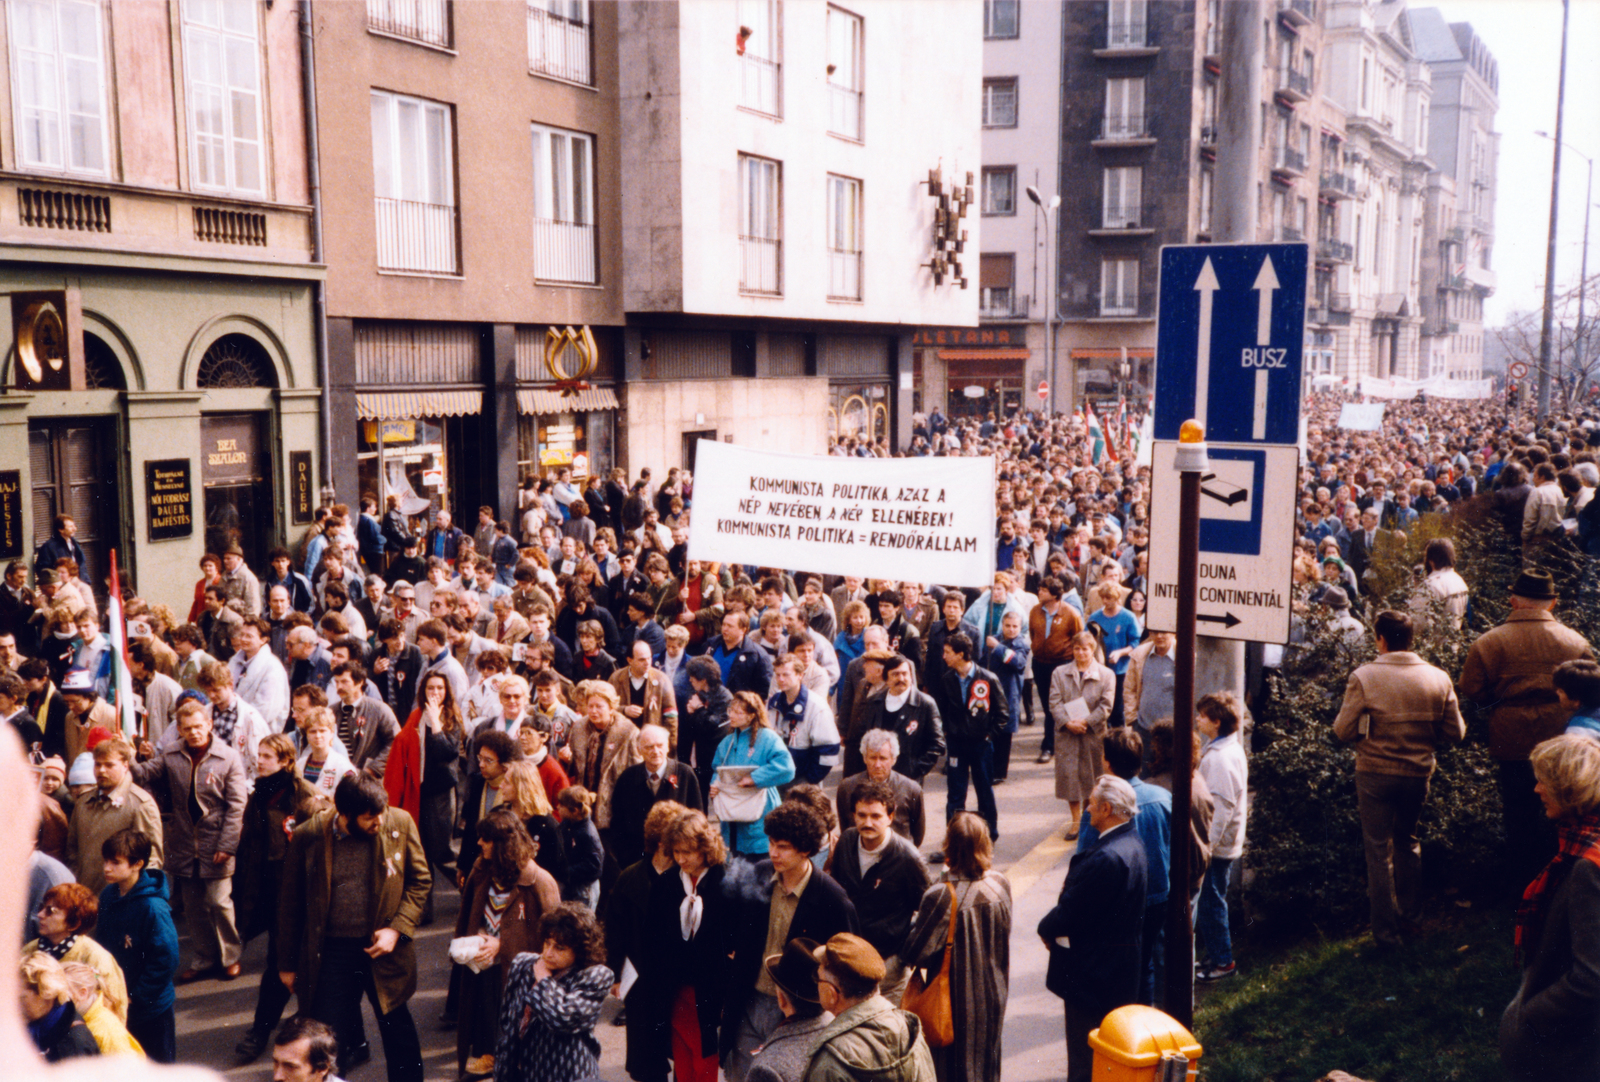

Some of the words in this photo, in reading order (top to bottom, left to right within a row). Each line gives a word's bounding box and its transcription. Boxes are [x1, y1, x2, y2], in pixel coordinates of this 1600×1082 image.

[1241, 348, 1287, 369] BUSZ
[298, 462, 308, 513] DAUER
[750, 476, 824, 497] KOMMUNISTA
[832, 483, 891, 503] POLITIKA,
[895, 488, 930, 502] AZAZ
[936, 488, 946, 503] A
[157, 504, 185, 516] DAUER
[738, 495, 762, 514] NÉP
[767, 499, 822, 522] NEVÉBEN,
[826, 507, 837, 521] A
[840, 504, 863, 522] NÉP
[871, 505, 954, 527] ELLENÉBEN!
[717, 518, 791, 540] KOMMUNISTA
[797, 525, 855, 544] POLITIKA
[869, 529, 977, 553] RENDŐRÁLLAM
[1200, 563, 1237, 580] DUNA
[1200, 586, 1285, 609] CONTINENTÁL
